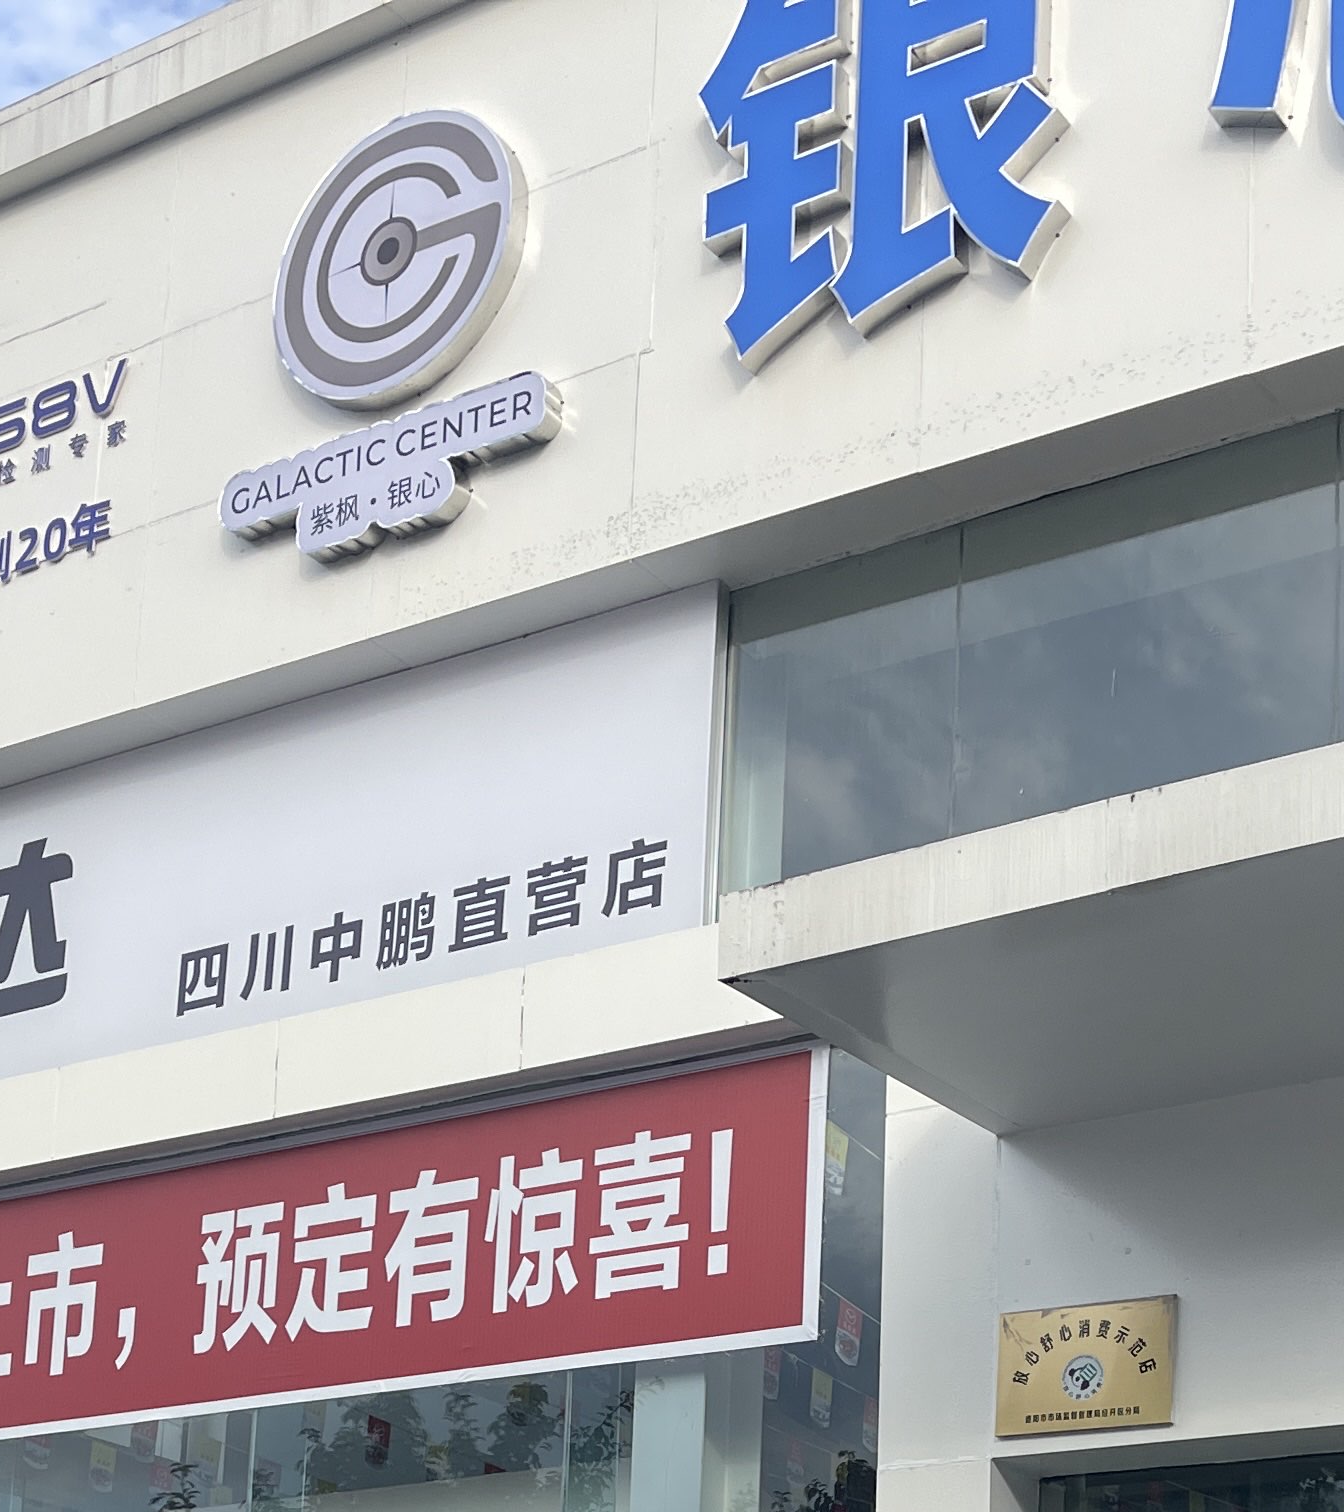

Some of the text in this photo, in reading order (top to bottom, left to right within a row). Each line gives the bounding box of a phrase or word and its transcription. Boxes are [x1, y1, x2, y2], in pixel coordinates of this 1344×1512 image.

[230, 390, 533, 516] GALACTIC CENTER
[175, 837, 669, 1018] 四川中鹏直营店
[1012, 1319, 1158, 1386] 放心舒心消费示范店
